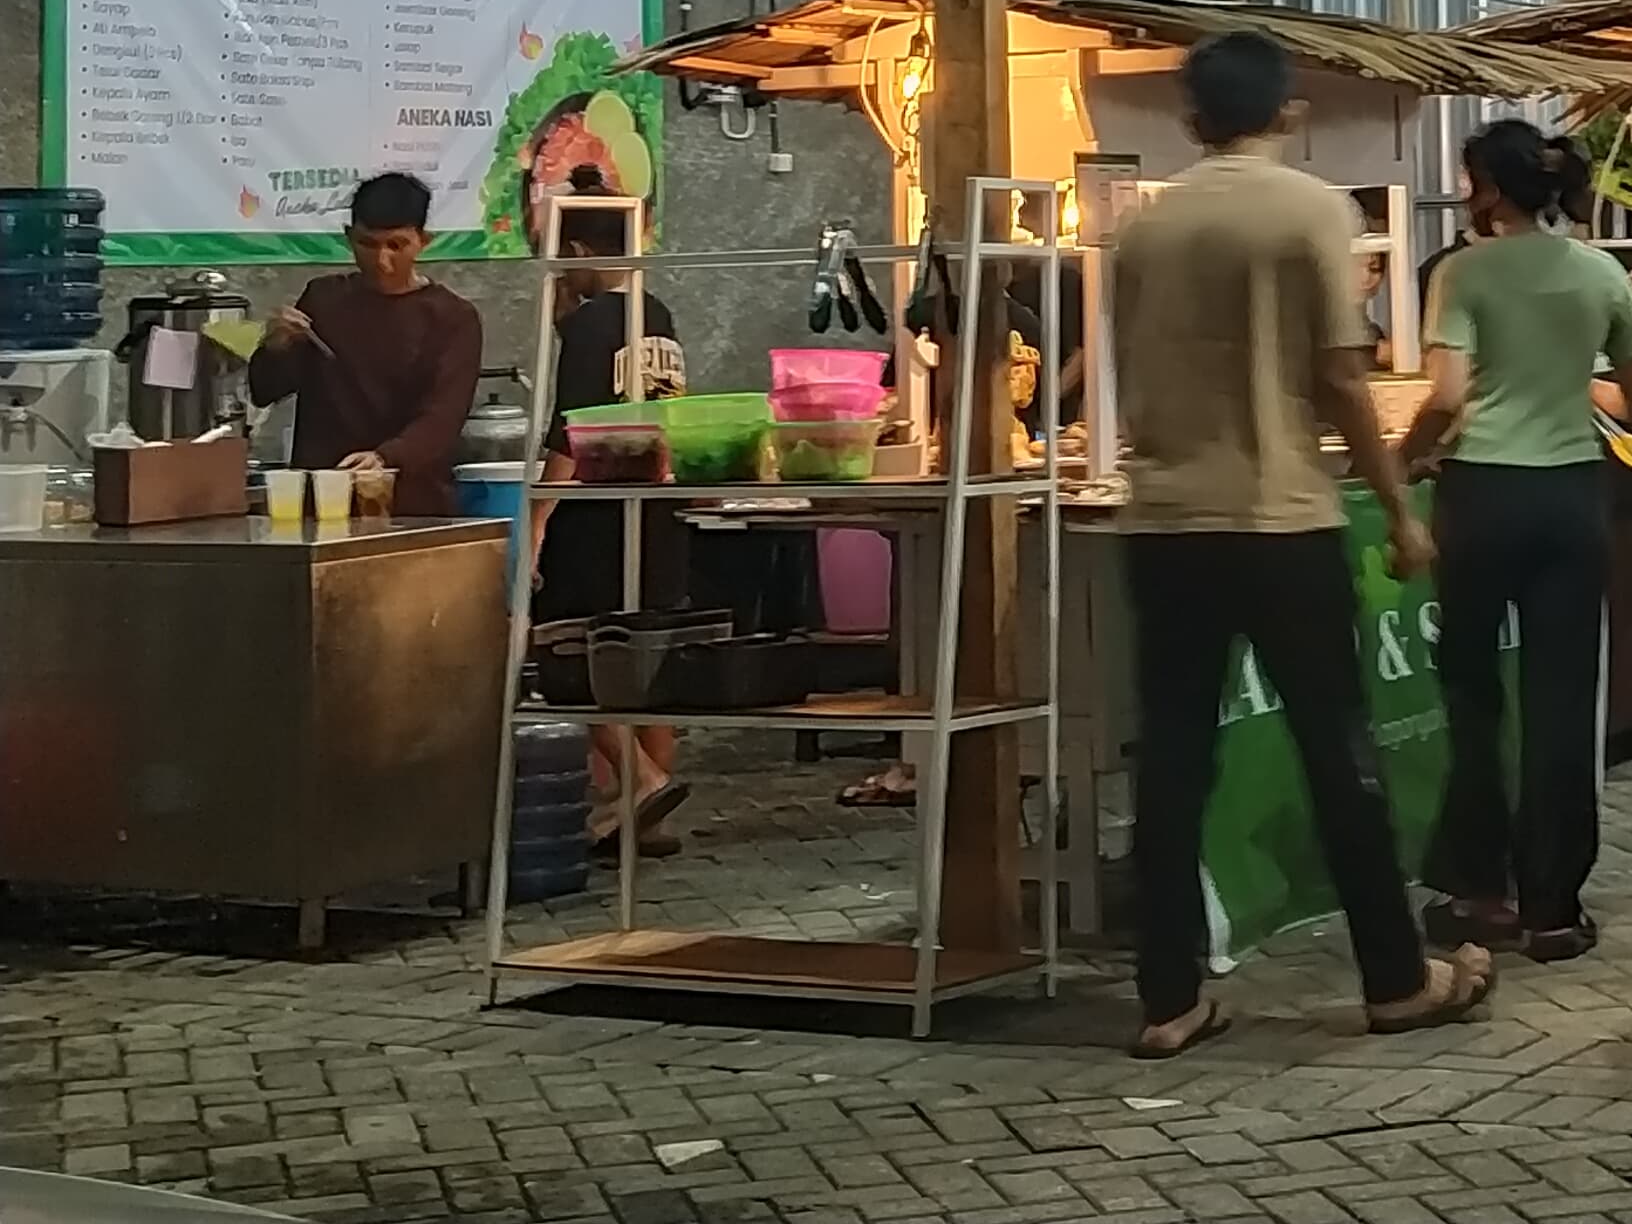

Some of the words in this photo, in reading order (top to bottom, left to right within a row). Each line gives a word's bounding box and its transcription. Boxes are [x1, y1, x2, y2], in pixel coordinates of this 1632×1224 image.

[397, 108, 452, 126] ANEKA
[455, 110, 493, 127] NASI
[1378, 610, 1414, 680] &
